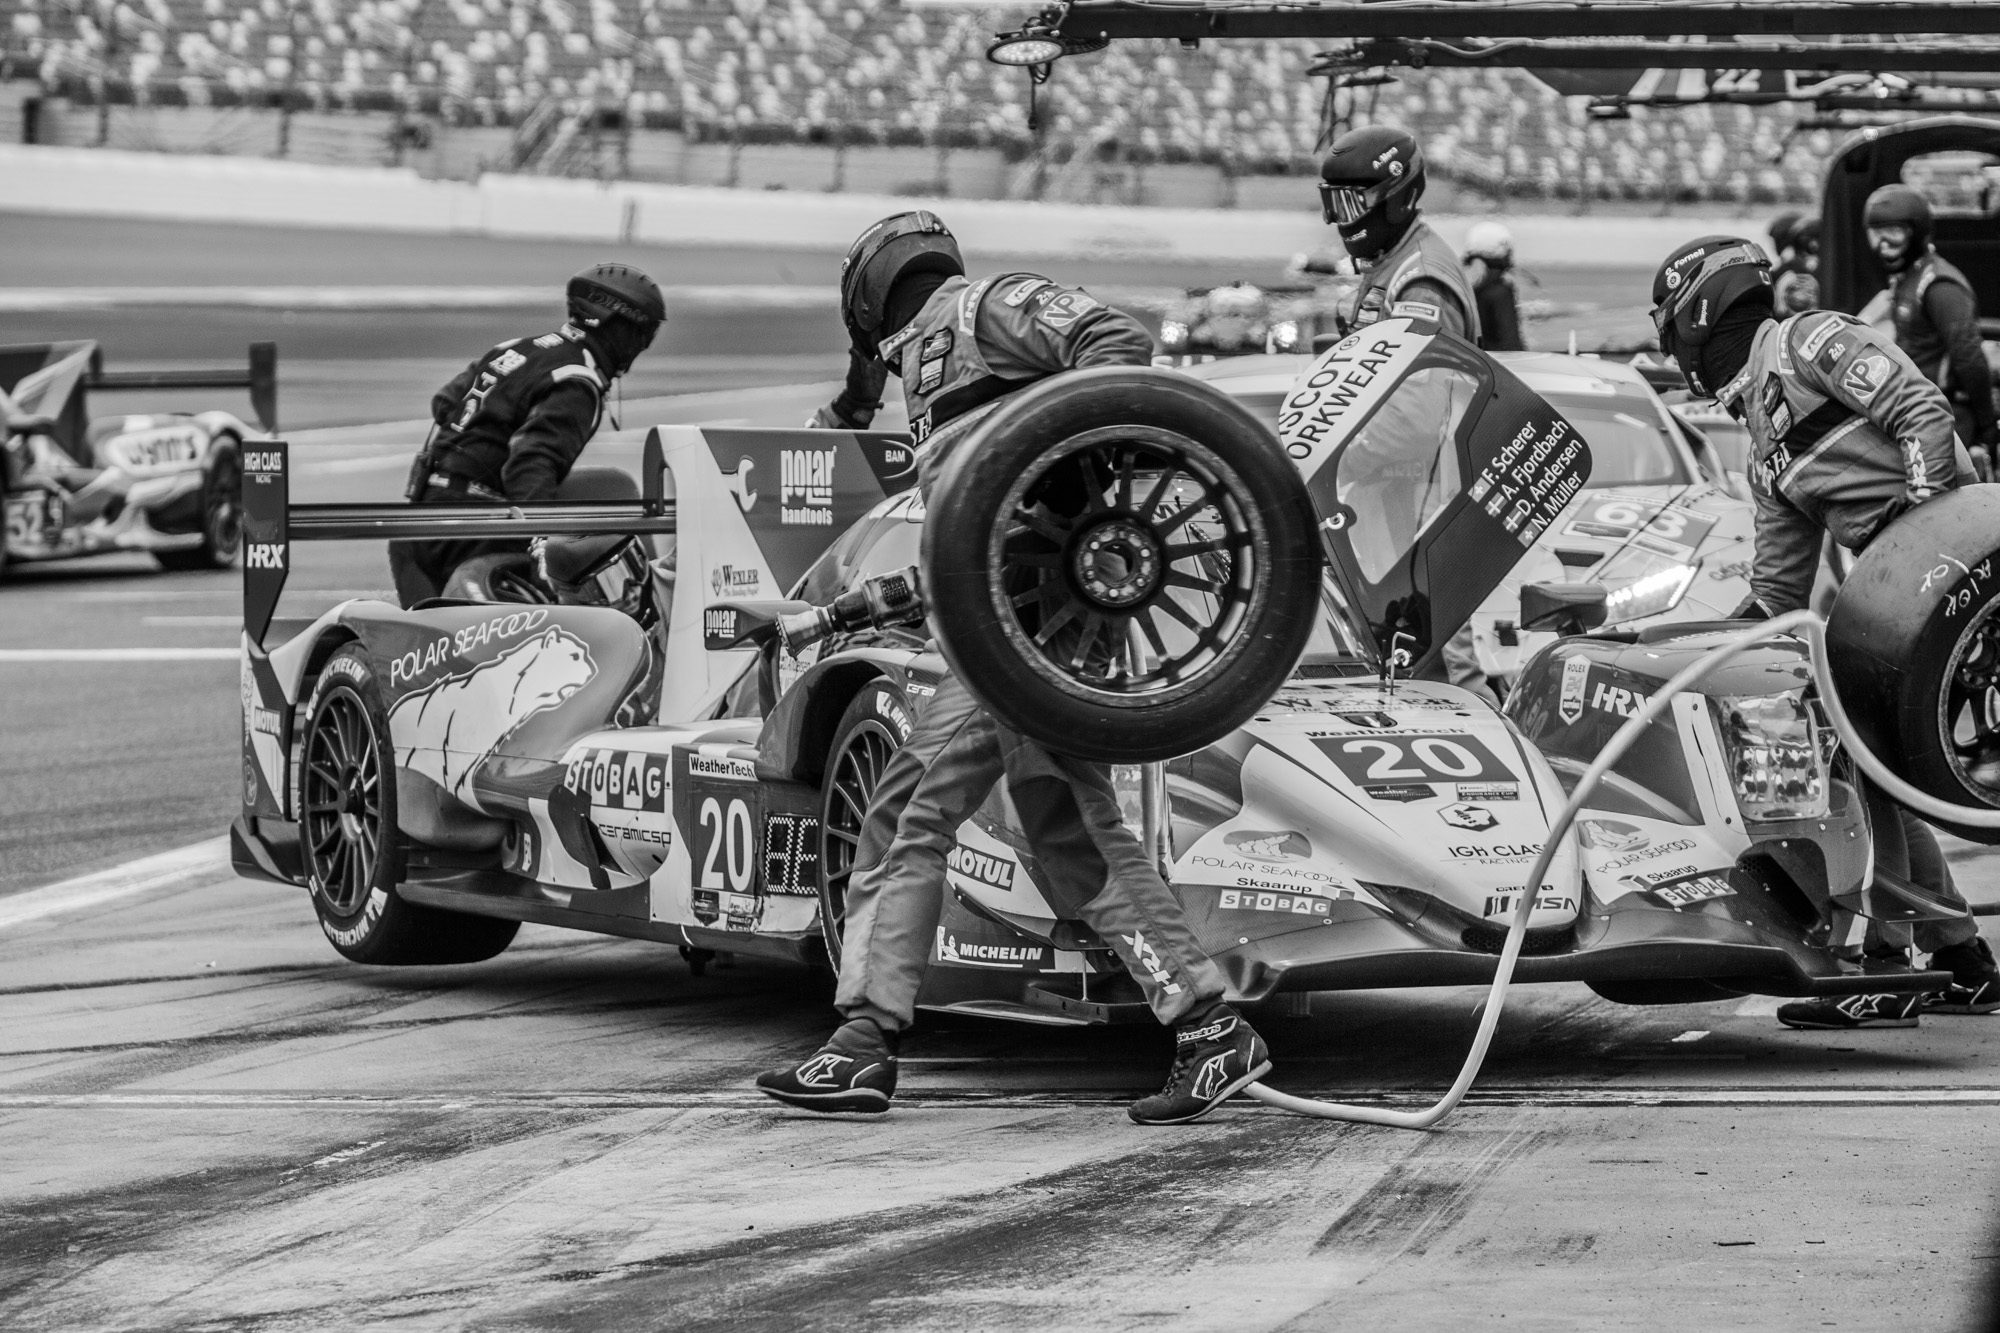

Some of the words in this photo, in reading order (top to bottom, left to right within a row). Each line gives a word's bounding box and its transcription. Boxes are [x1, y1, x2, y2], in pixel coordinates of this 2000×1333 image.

[1845, 358, 1879, 393] VP
[1287, 340, 1402, 460] ORKWEAR
[885, 450, 905, 462] BAM
[1482, 468, 1500, 485] F.
[1492, 421, 1537, 474] Scherer
[1501, 478, 1520, 501] A.
[1511, 420, 1569, 485] Fjordbach
[1516, 499, 1536, 516] D.
[1529, 439, 1583, 502] Andersen
[781, 506, 833, 525] handtools
[1531, 512, 1552, 532] N.
[1544, 471, 1583, 517] Müller
[246, 544, 285, 568] HRX
[391, 637, 450, 688] POLAR
[452, 609, 548, 657] SEAFOOD
[318, 657, 366, 691] MICHELIN
[1567, 663, 1586, 673] ROLEX
[1592, 682, 1652, 724] HRX
[255, 709, 281, 736] MOTUL
[890, 706, 912, 742] MIC
[1304, 727, 1465, 738] WeatherTech
[690, 756, 755, 778] WeatherTech
[1342, 738, 1484, 780] 20
[566, 761, 661, 798] STOBAG
[700, 797, 753, 892] 20
[1492, 844, 1547, 857] CLAS
[1596, 853, 1640, 874] POLAR
[1639, 838, 1698, 859] SEAFOOD
[946, 845, 1012, 887] MOTUL
[1191, 855, 1255, 872] POLAR
[1260, 864, 1343, 884] SEAFOOD
[1647, 864, 1698, 882] Skaarup
[1236, 877, 1312, 894] Skaarup
[1664, 878, 1731, 902] STOBAG
[1224, 894, 1328, 914] STOBAG
[323, 914, 370, 946] MICHELIN
[960, 943, 1043, 960] MICHELIN
[1121, 930, 1182, 995] HRX
